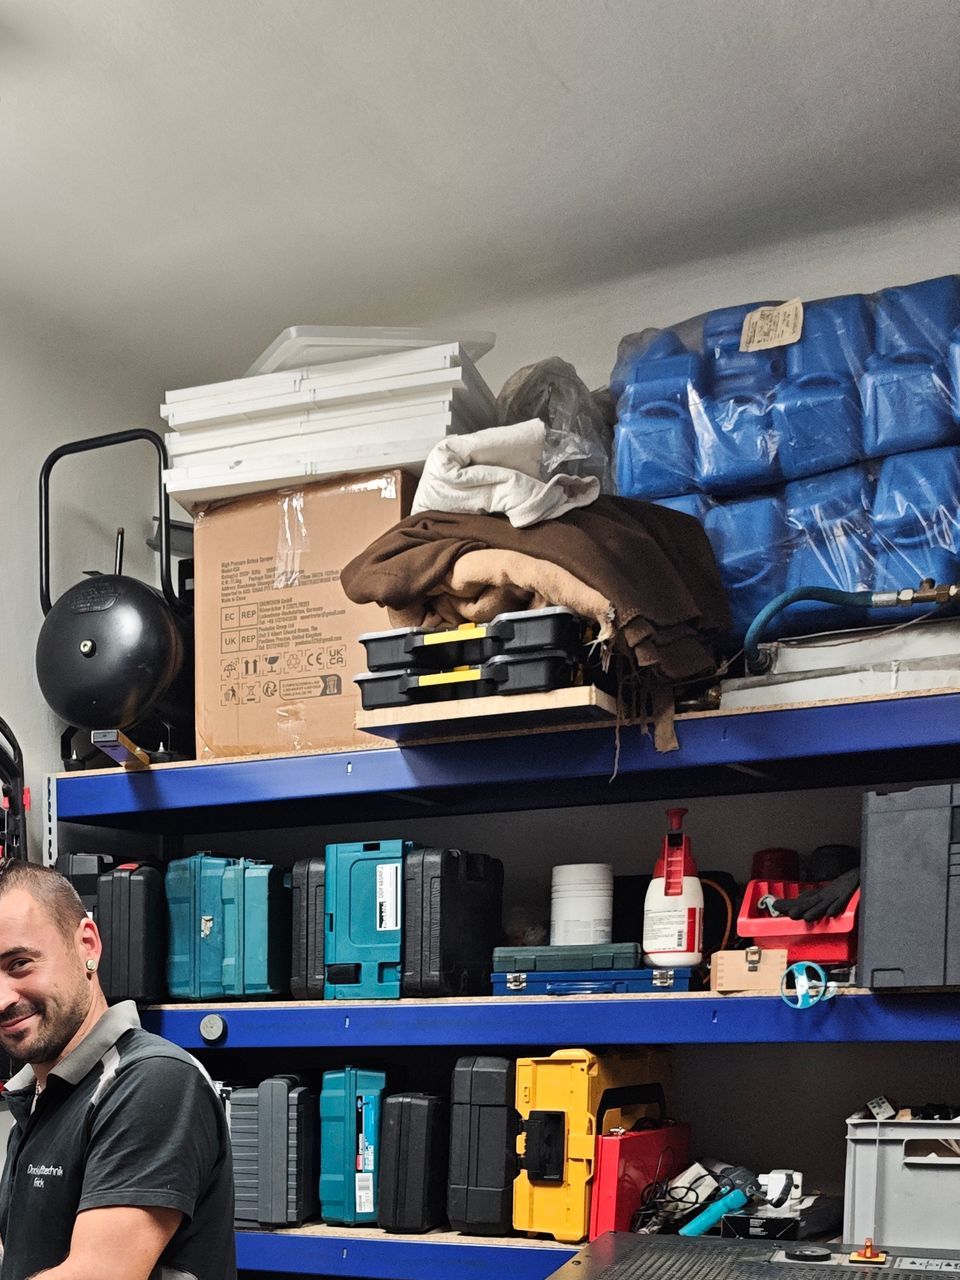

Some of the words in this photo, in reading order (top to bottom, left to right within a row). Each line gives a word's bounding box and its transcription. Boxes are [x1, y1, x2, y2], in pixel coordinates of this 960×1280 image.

[224, 613, 235, 621] EC
[241, 610, 256, 618] REP
[224, 637, 237, 645] UK
[241, 635, 256, 643] REP
[329, 648, 343, 657] UK
